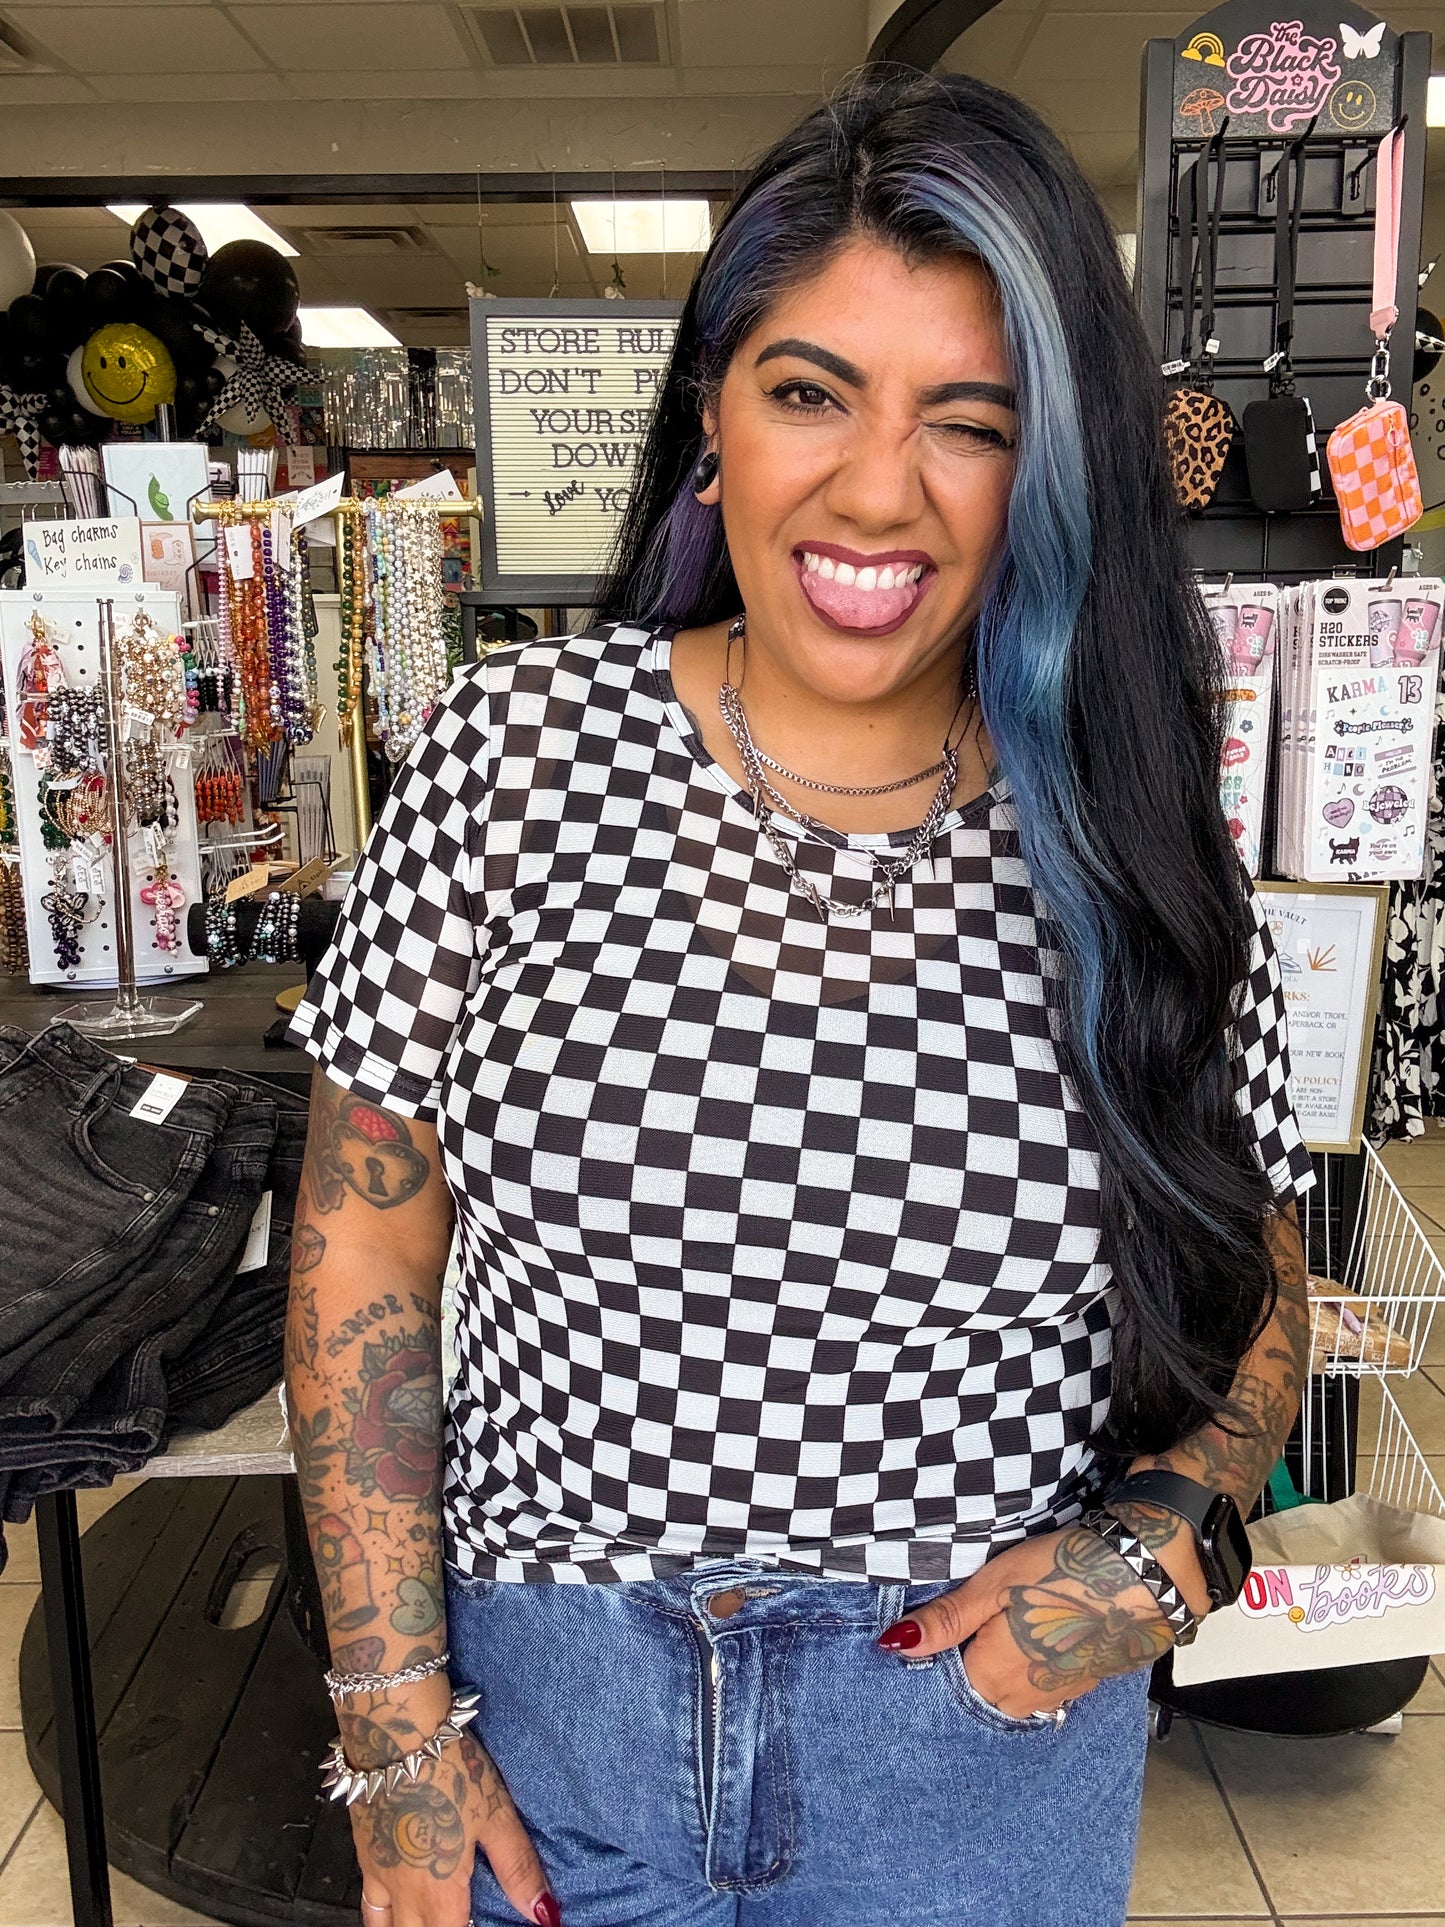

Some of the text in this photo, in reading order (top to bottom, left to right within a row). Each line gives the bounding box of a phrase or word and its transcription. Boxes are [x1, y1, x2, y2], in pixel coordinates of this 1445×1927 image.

[1272, 22, 1301, 46] the
[1229, 36, 1338, 80] Black
[1229, 75, 1330, 128] Daisy
[500, 328, 600, 354] STORE
[499, 367, 601, 394] DON'T
[542, 479, 585, 515] love
[42, 524, 119, 553] Bag charms
[44, 552, 118, 579] Key chains
[1319, 634, 1379, 648] STICKERS
[1327, 675, 1388, 704] KARMA
[1398, 675, 1423, 705] 13
[1362, 799, 1415, 812] Bejeweled
[1278, 909, 1308, 925] VAULT
[1305, 1050, 1322, 1058] NEW
[1245, 1563, 1434, 1625] ON books
[413, 1598, 426, 1619] UR
